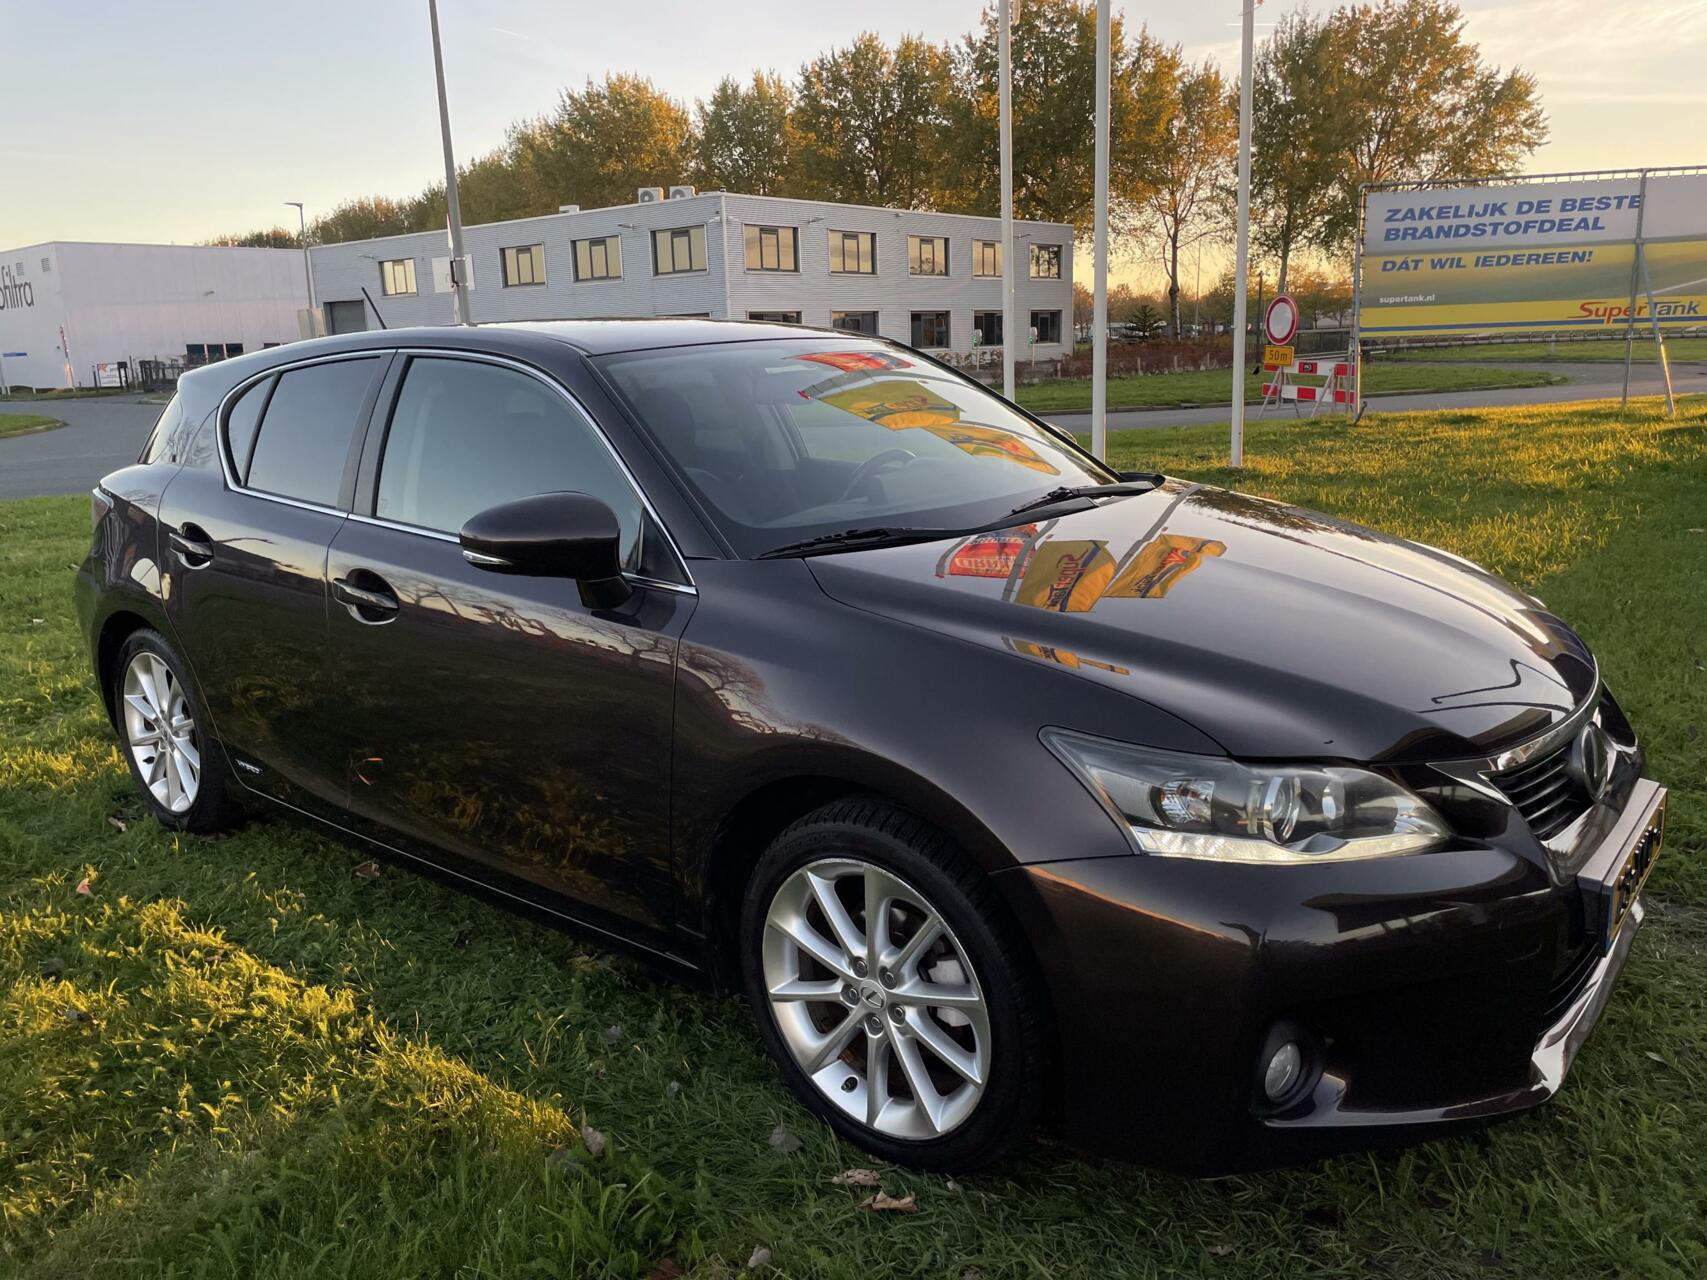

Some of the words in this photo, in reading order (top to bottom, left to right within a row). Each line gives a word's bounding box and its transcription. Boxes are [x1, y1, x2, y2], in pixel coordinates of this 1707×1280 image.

[1384, 202, 1508, 222] ZAKELIJK
[1515, 199, 1552, 215] DE
[1559, 194, 1643, 213] BESTE
[1384, 216, 1605, 241] BRANDSTOFDEAL
[1381, 256, 1424, 272] DÁT
[1430, 257, 1466, 270] WIL
[1474, 250, 1593, 268] IEDEREEN!
[1379, 293, 1436, 305] supertank.nl
